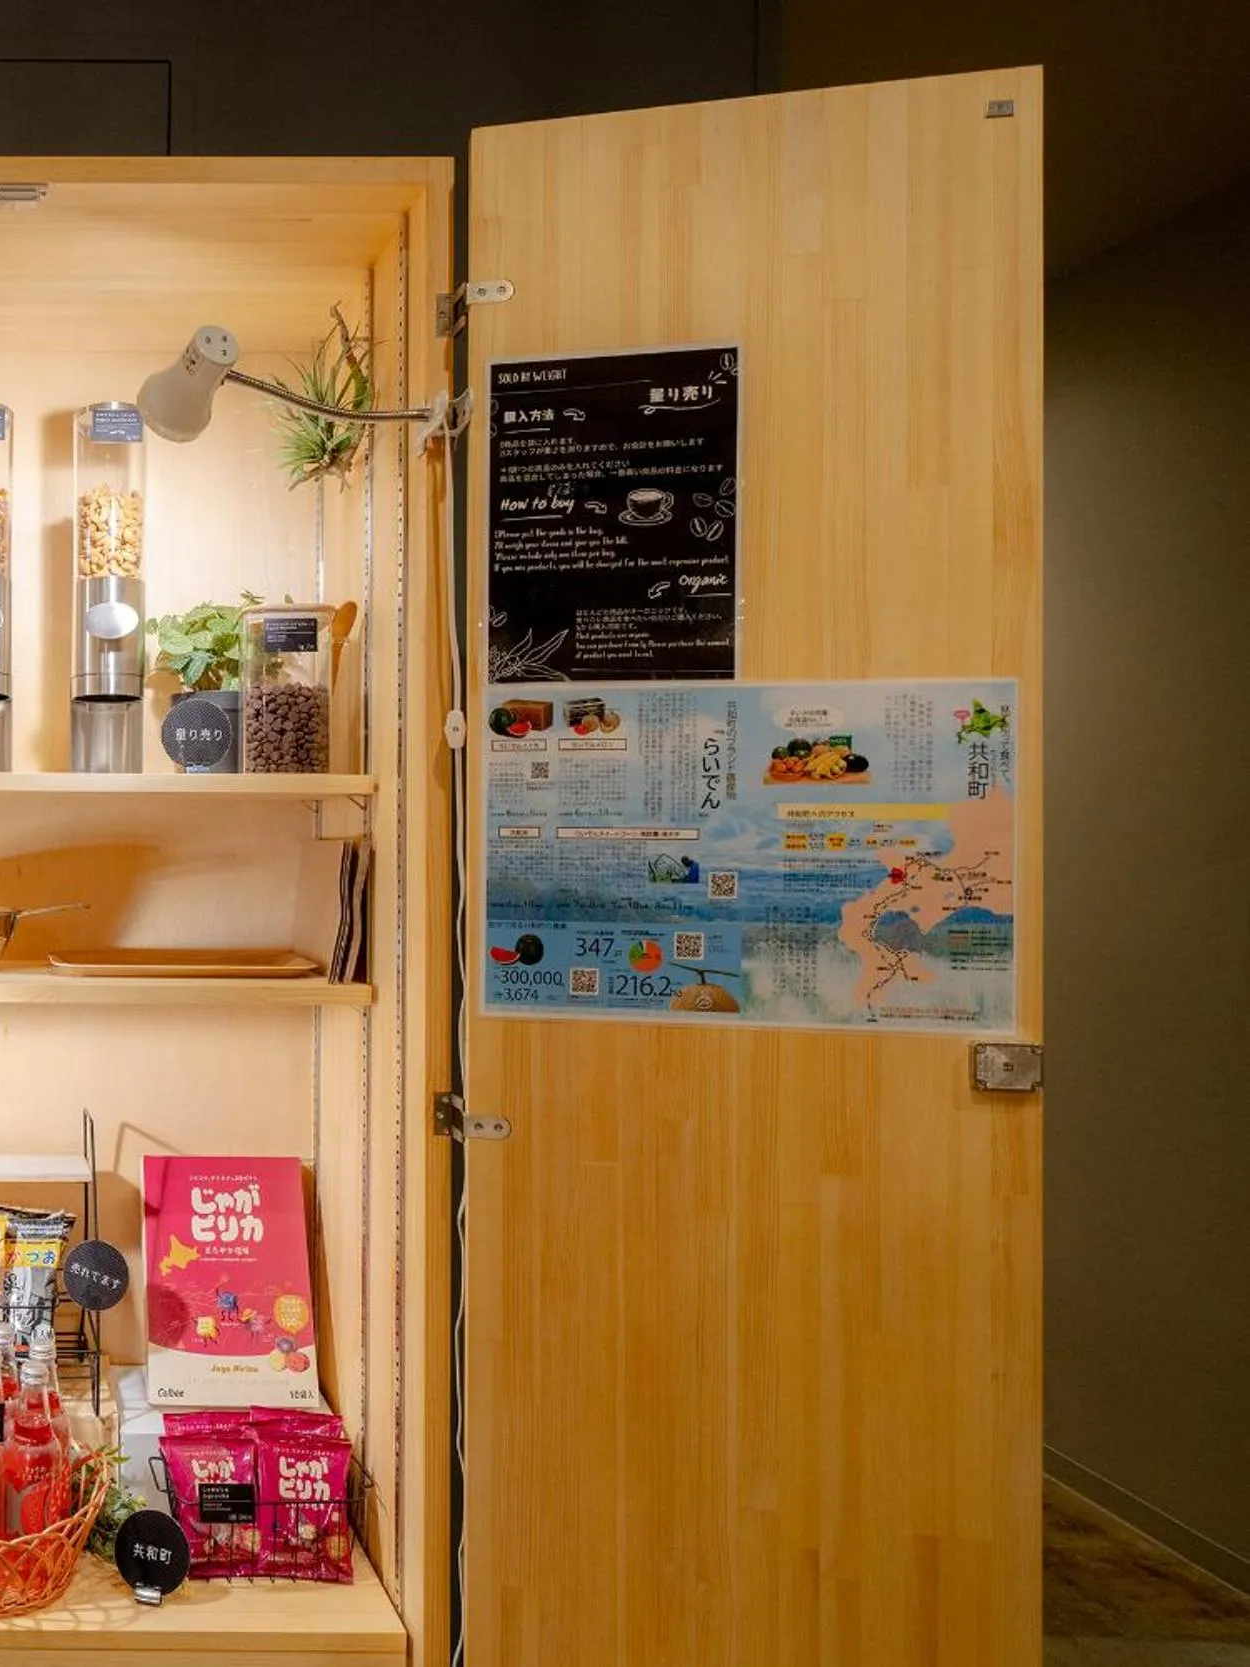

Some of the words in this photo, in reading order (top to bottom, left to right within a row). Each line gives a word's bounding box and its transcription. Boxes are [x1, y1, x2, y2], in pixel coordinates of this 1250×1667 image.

[498, 372, 519, 385] SOLD
[649, 385, 713, 403] 量り売り
[503, 408, 554, 423] 購入方法
[501, 498, 527, 511] How
[533, 497, 547, 510] to
[551, 495, 575, 514] buy
[678, 574, 728, 595] Organic
[175, 727, 223, 742] 量り売り
[701, 737, 721, 810] らいでん
[967, 741, 990, 800] 共和町
[191, 1183, 261, 1214] じゃが
[191, 1214, 264, 1242] ピリカ
[70, 1262, 121, 1290] 売れてます
[191, 1457, 236, 1479] じゃが
[278, 1456, 330, 1480] じゃが
[278, 1478, 331, 1502] ピリカ
[132, 1543, 173, 1565] 共和町
